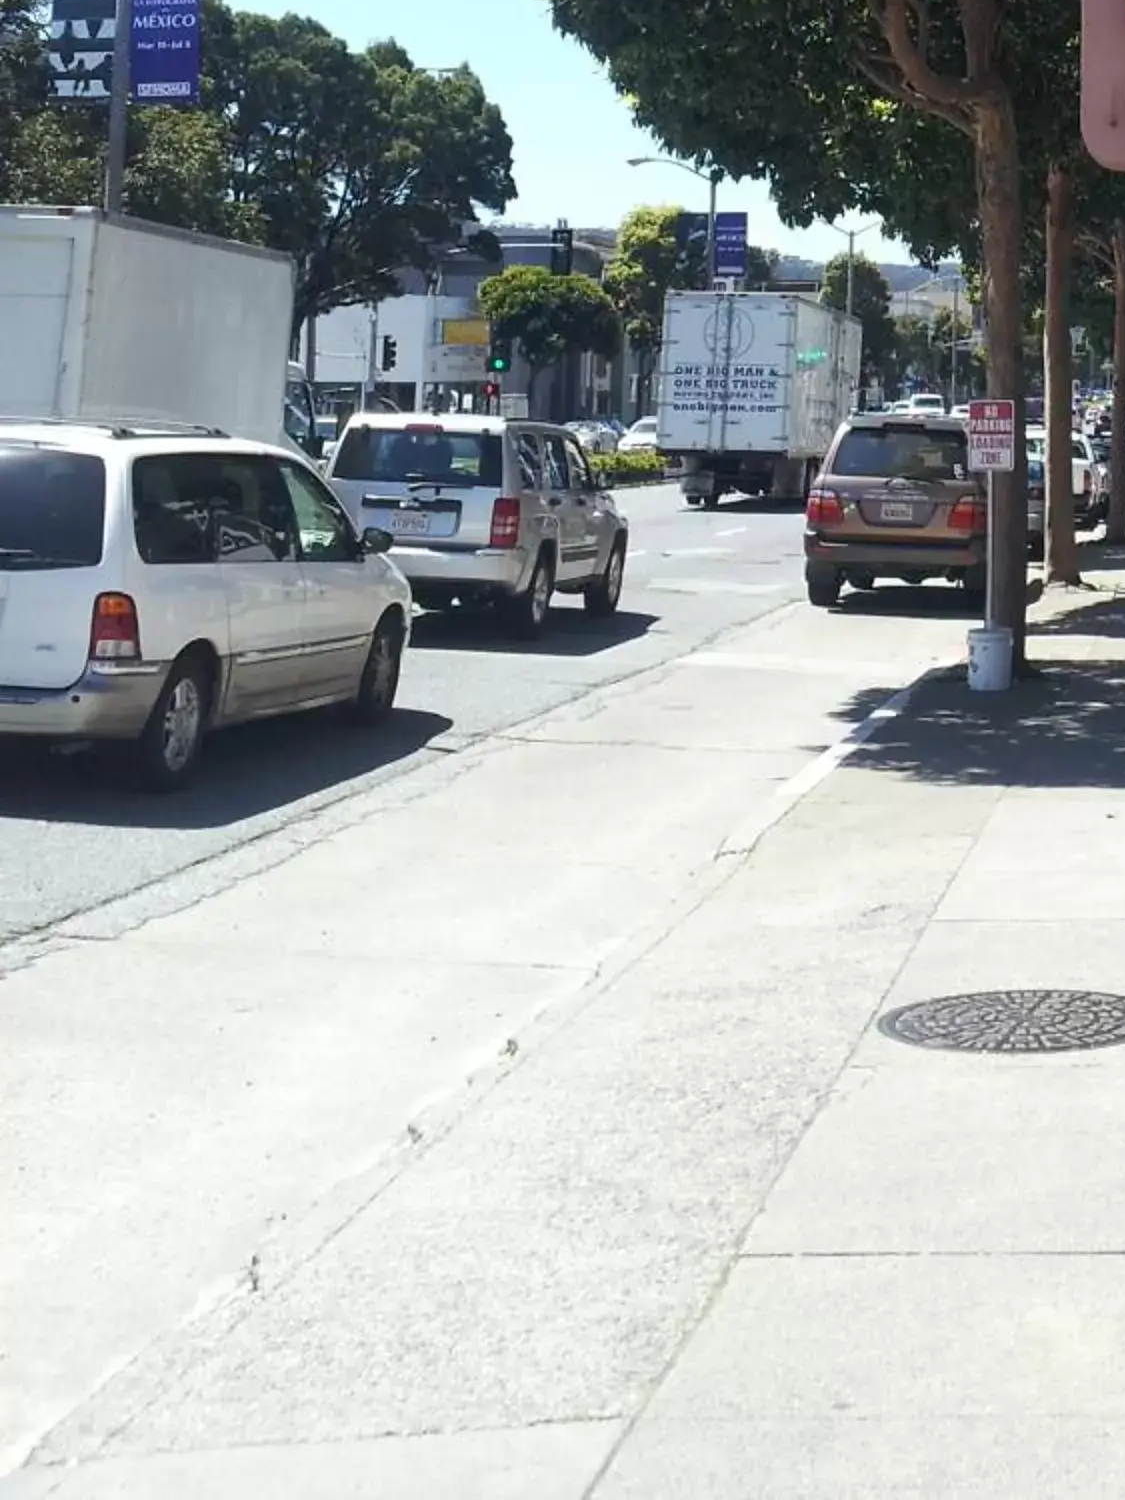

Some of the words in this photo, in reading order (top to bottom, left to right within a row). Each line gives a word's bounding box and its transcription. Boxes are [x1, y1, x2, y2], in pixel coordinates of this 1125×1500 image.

[133, 12, 196, 29] MÉXICO
[674, 366, 701, 375] ONE
[734, 367, 764, 376] MAN
[674, 380, 701, 388] ONE
[706, 380, 729, 389] BIG
[732, 380, 777, 389] TRUCK
[970, 419, 1012, 432] PARKING
